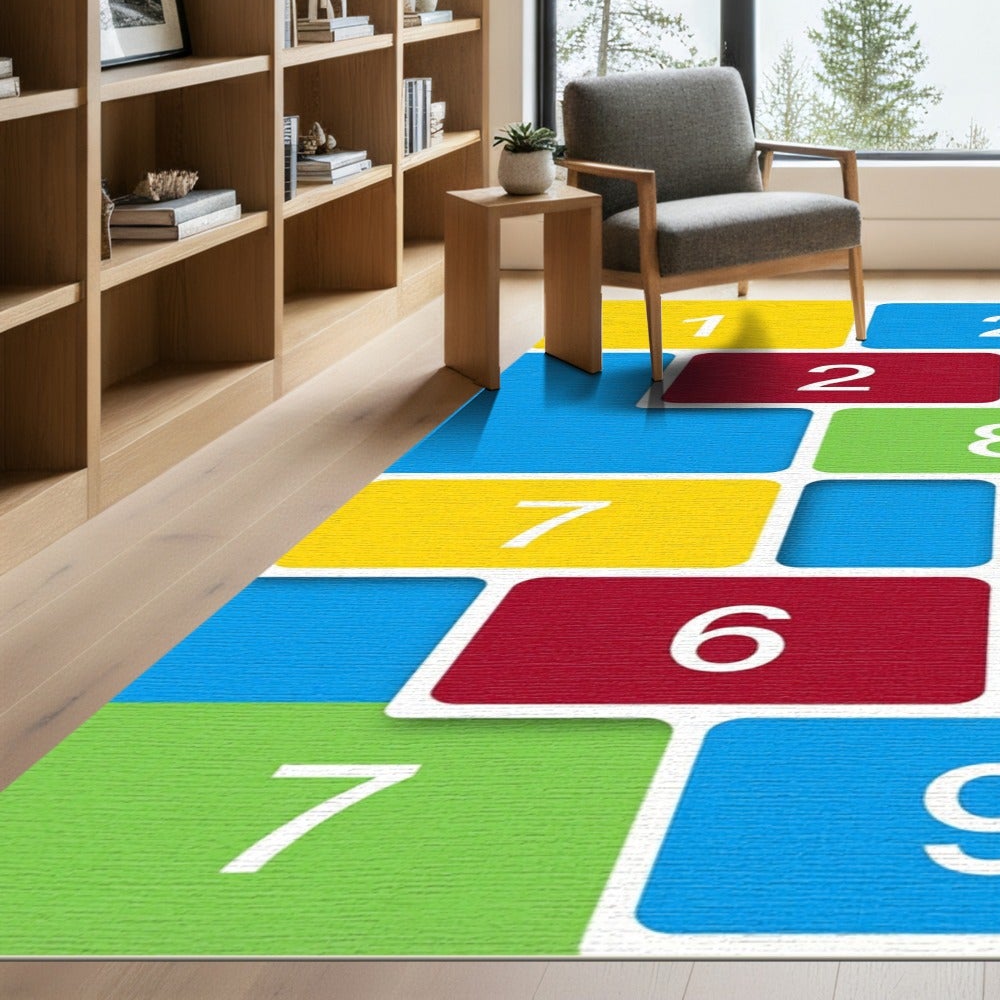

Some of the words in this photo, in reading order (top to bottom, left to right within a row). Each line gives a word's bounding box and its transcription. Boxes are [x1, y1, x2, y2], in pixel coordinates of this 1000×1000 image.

[684, 315, 724, 337] 1
[797, 364, 877, 391] 2
[501, 500, 611, 548] 7
[669, 604, 791, 673] 6
[219, 763, 422, 874] 7
